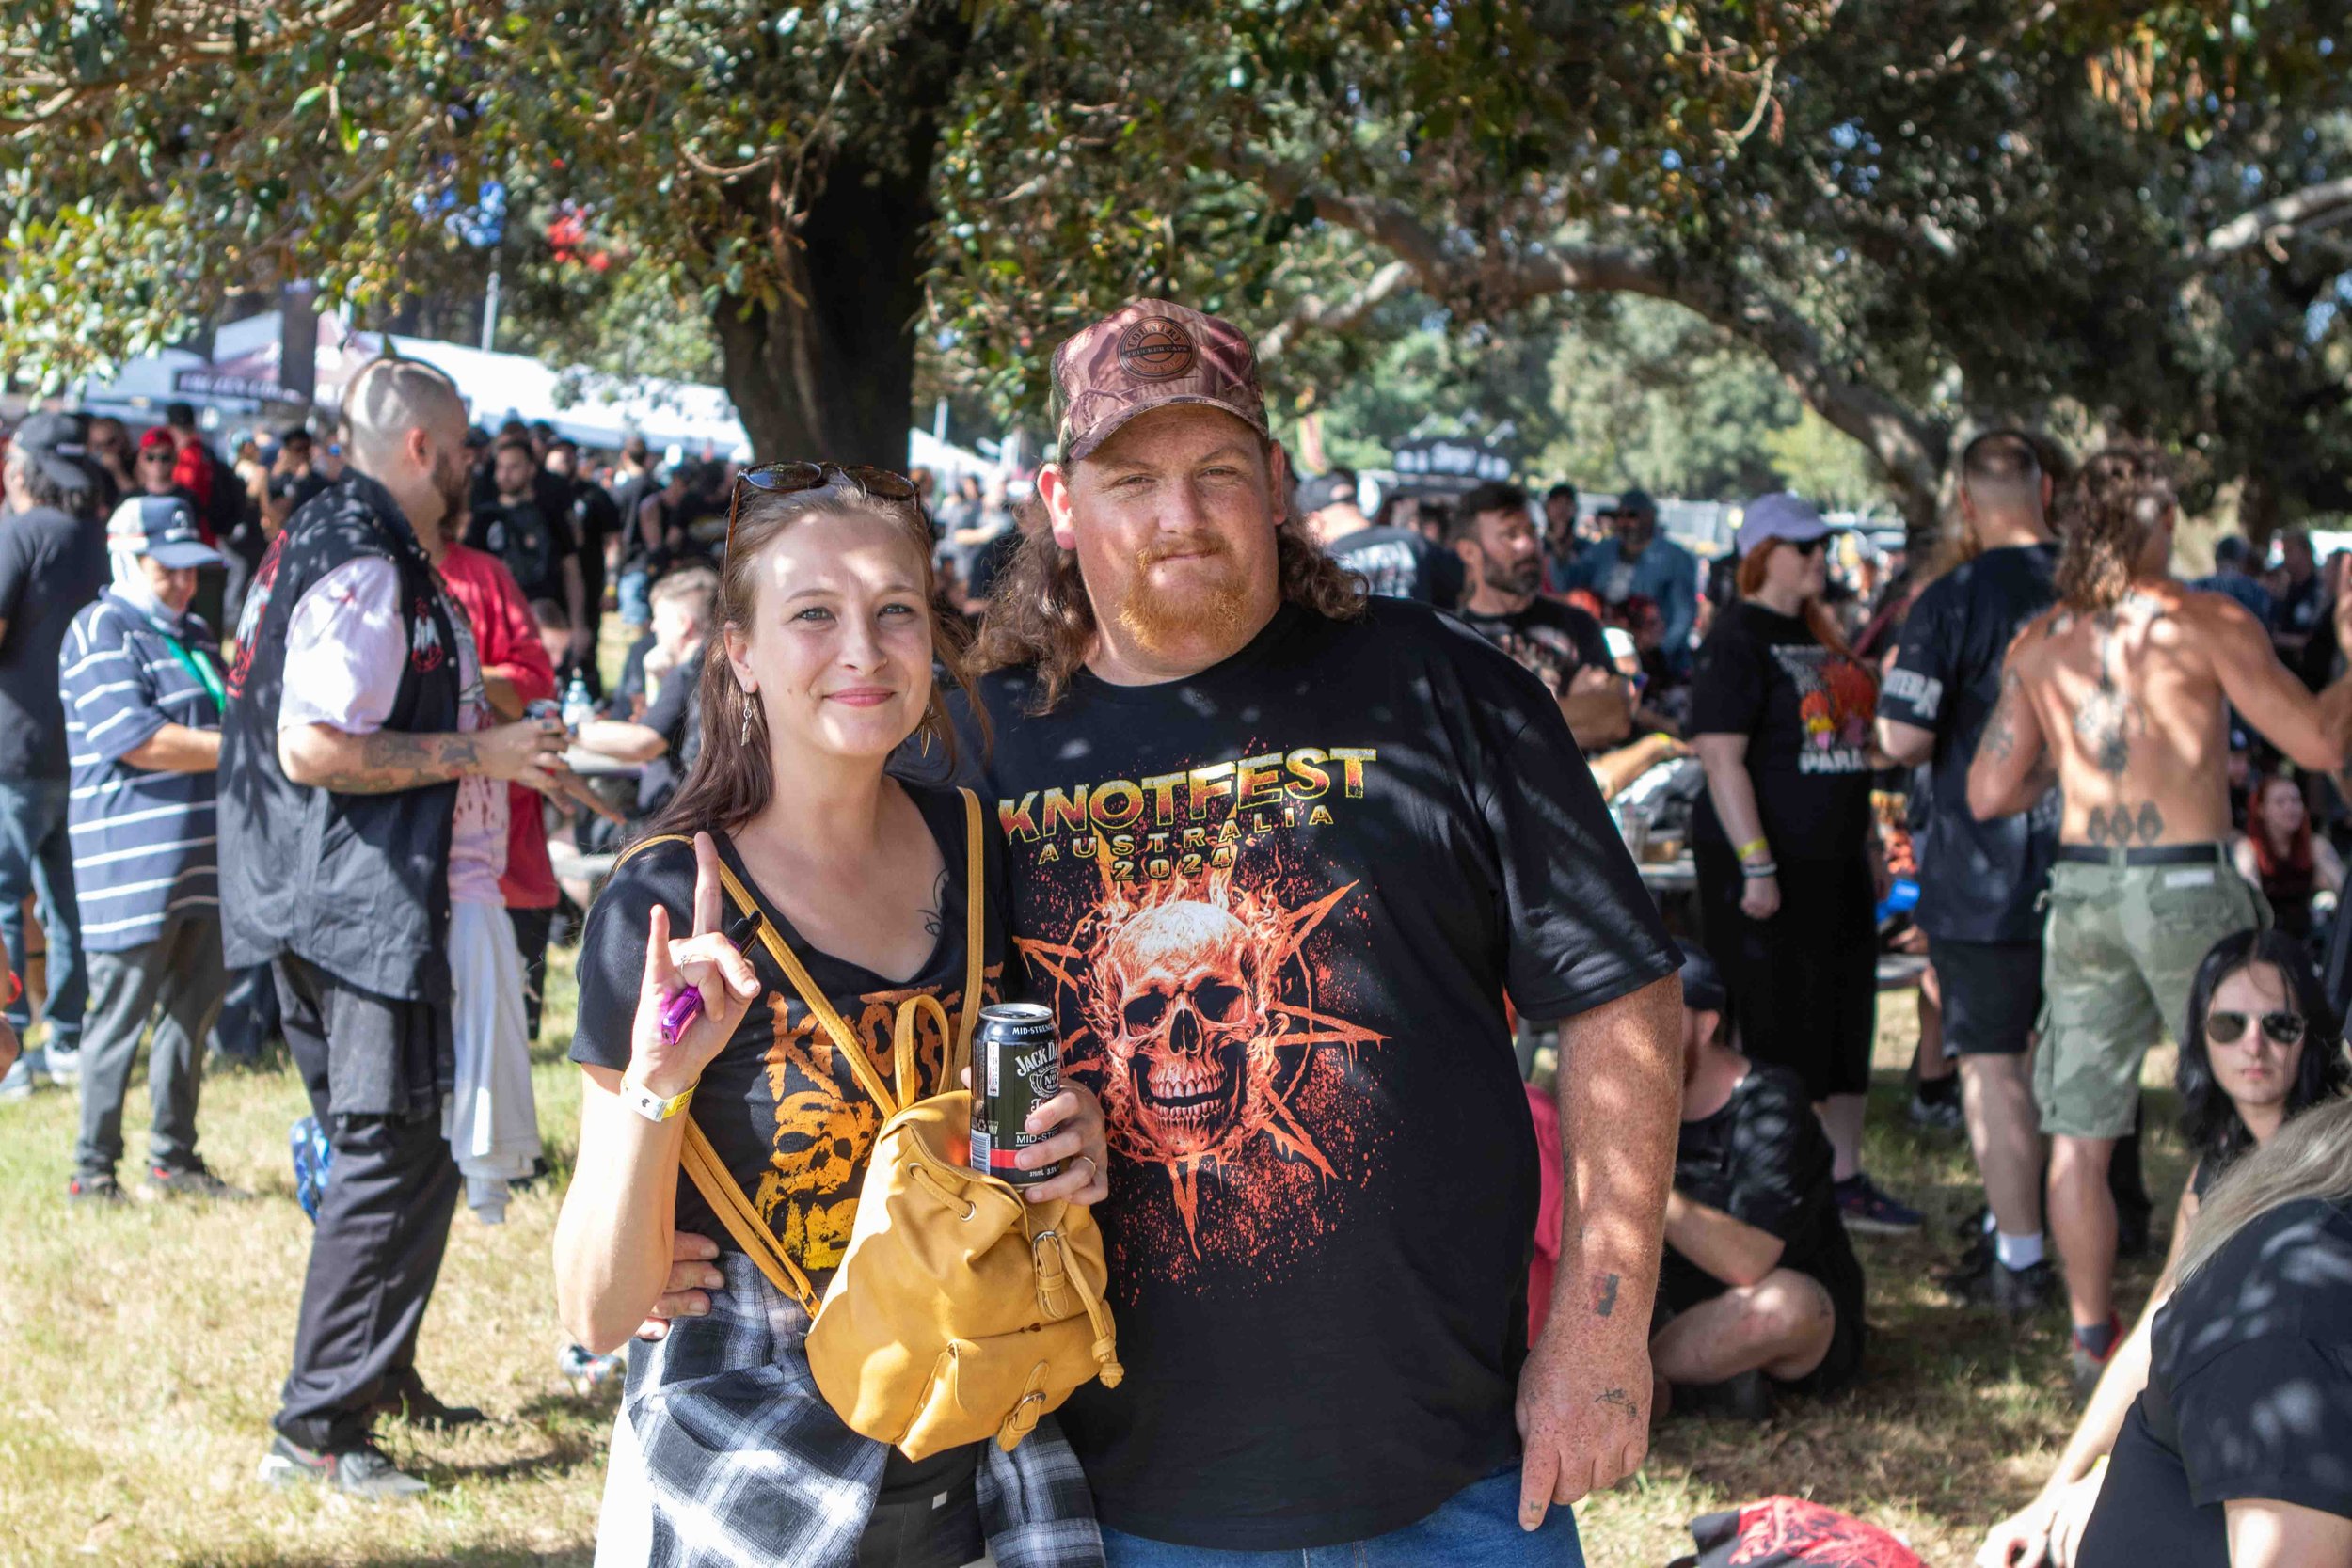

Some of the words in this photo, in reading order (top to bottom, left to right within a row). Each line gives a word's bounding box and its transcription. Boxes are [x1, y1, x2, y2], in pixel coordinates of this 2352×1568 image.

[998, 747, 1377, 846] KNOTFEST
[1038, 804, 1334, 864] AUSTRALIA
[1114, 845, 1233, 881] 2024
[1015, 1048, 1048, 1077] JACK
